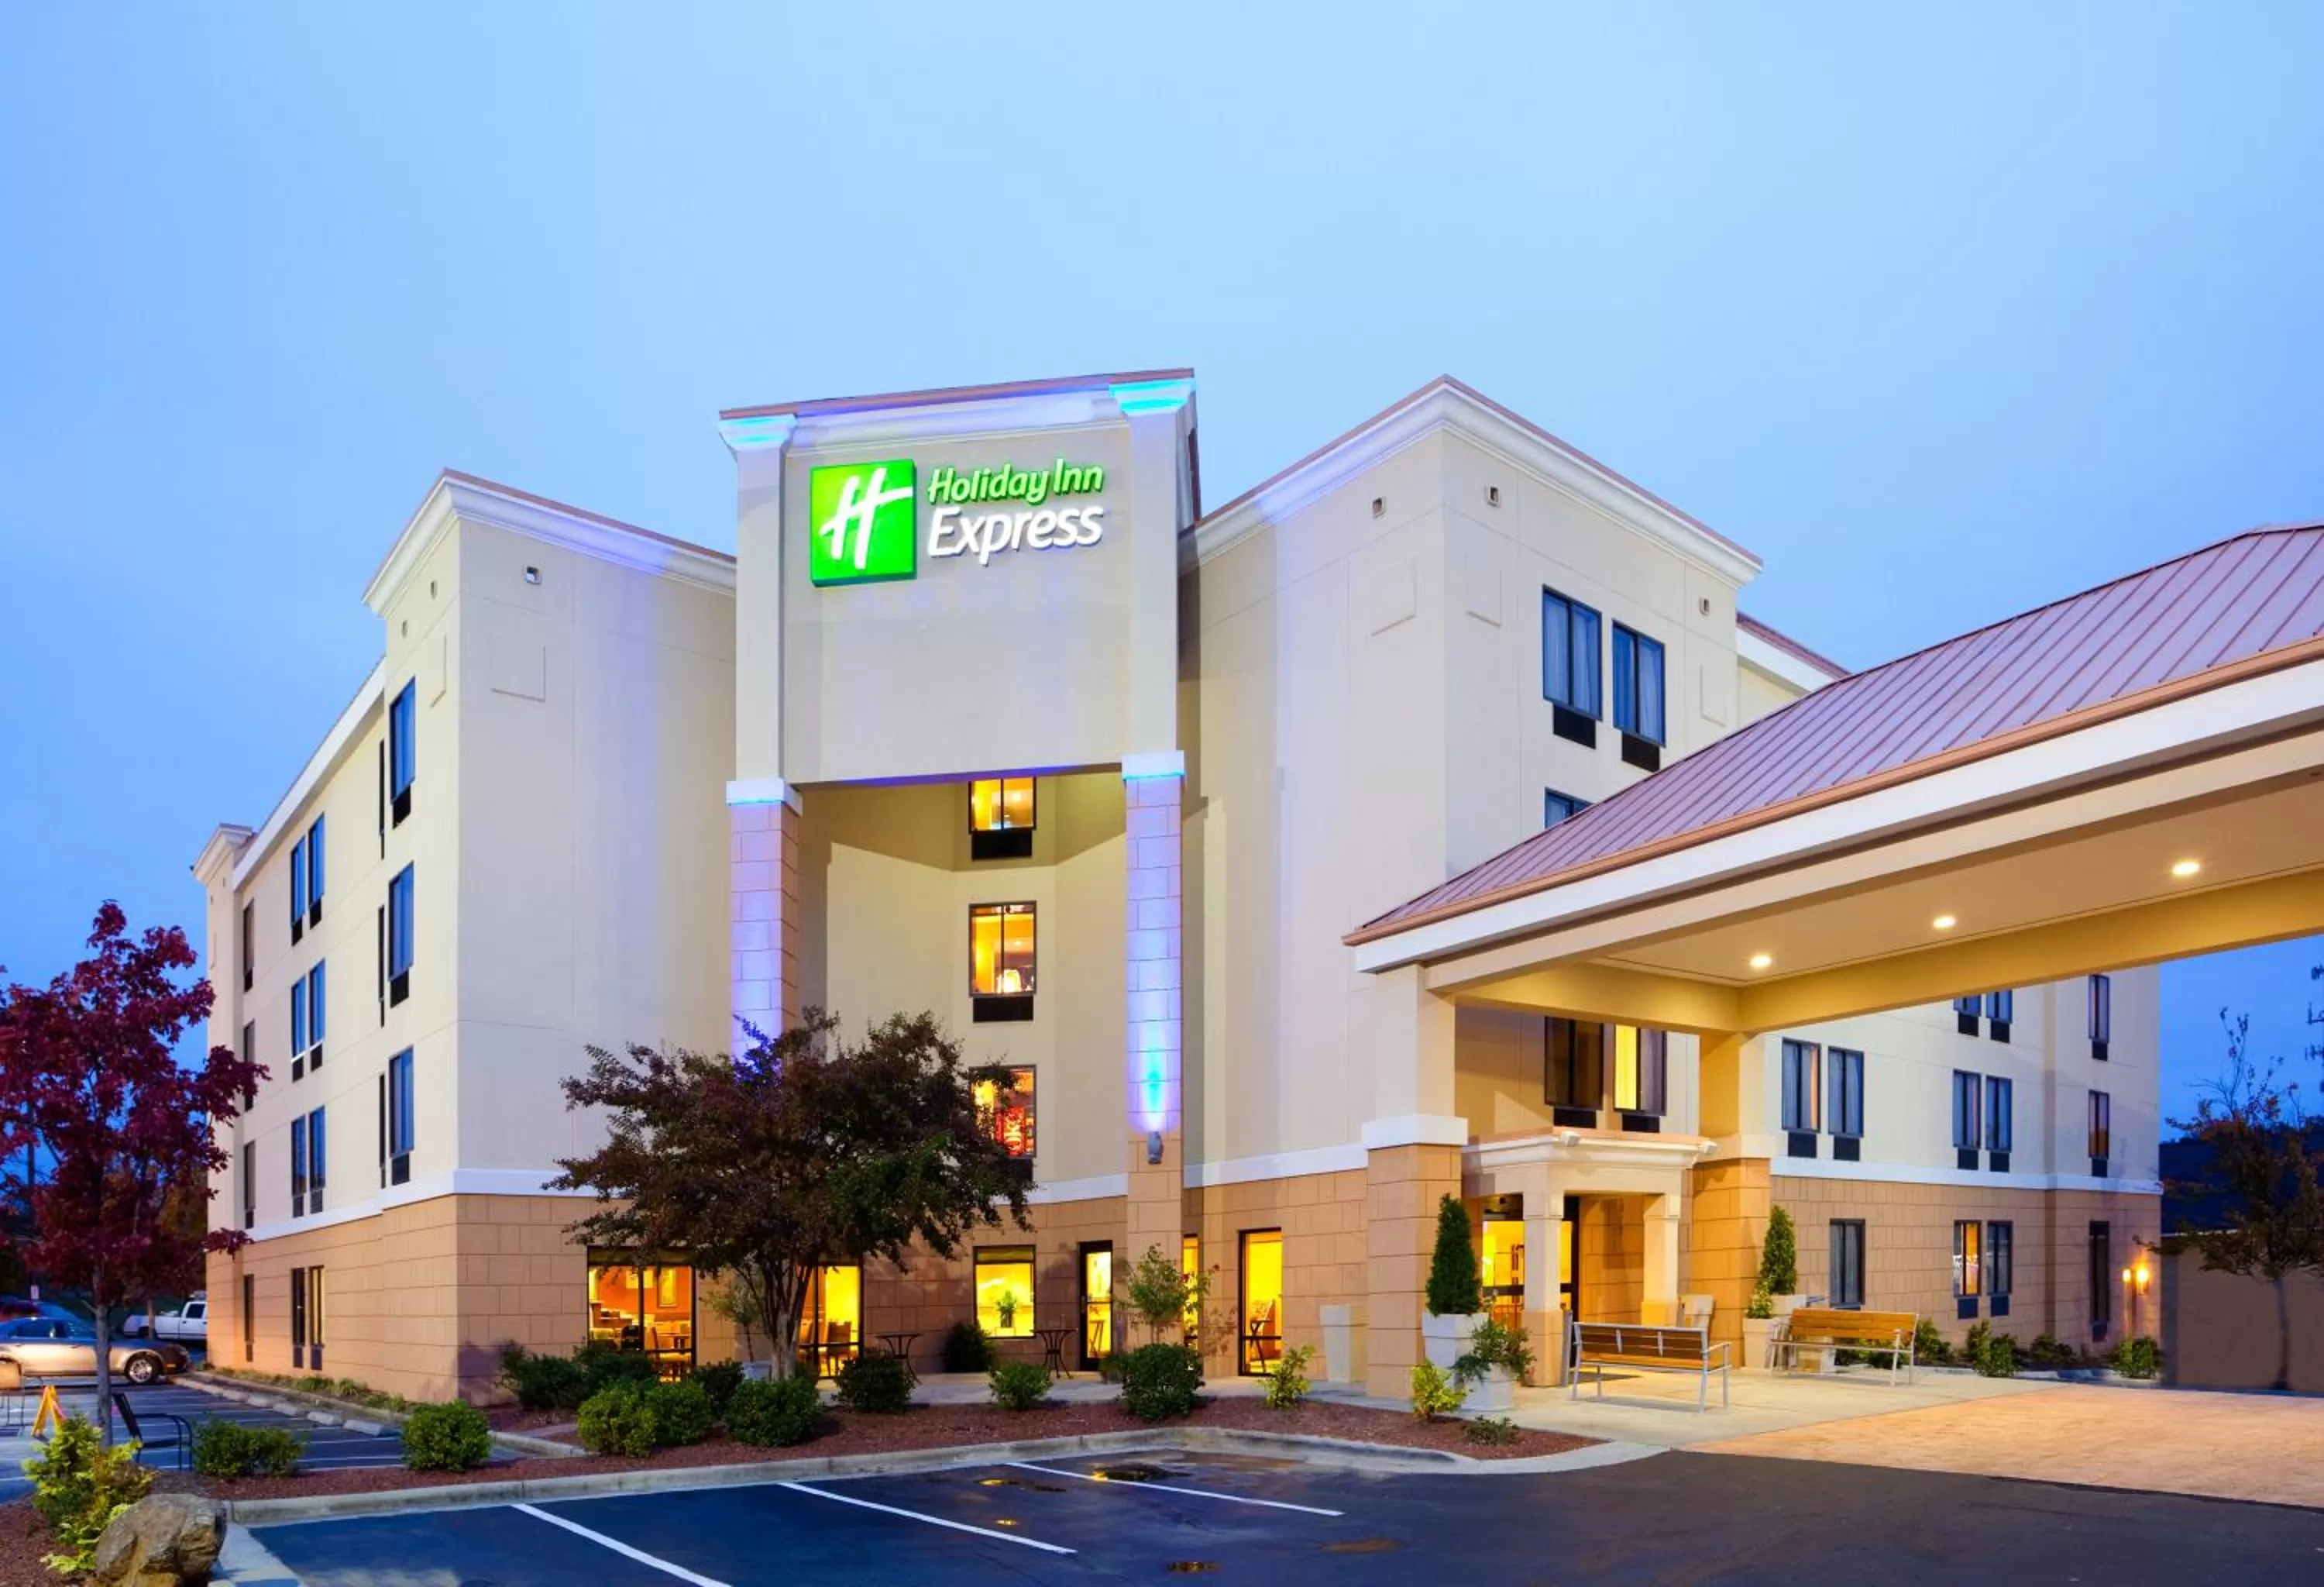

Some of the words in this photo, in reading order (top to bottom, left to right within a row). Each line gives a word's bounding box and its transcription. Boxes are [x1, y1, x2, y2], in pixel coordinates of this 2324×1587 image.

[927, 463, 1049, 504] Holiday
[1054, 458, 1103, 493] Inn
[927, 505, 1104, 566] Express
